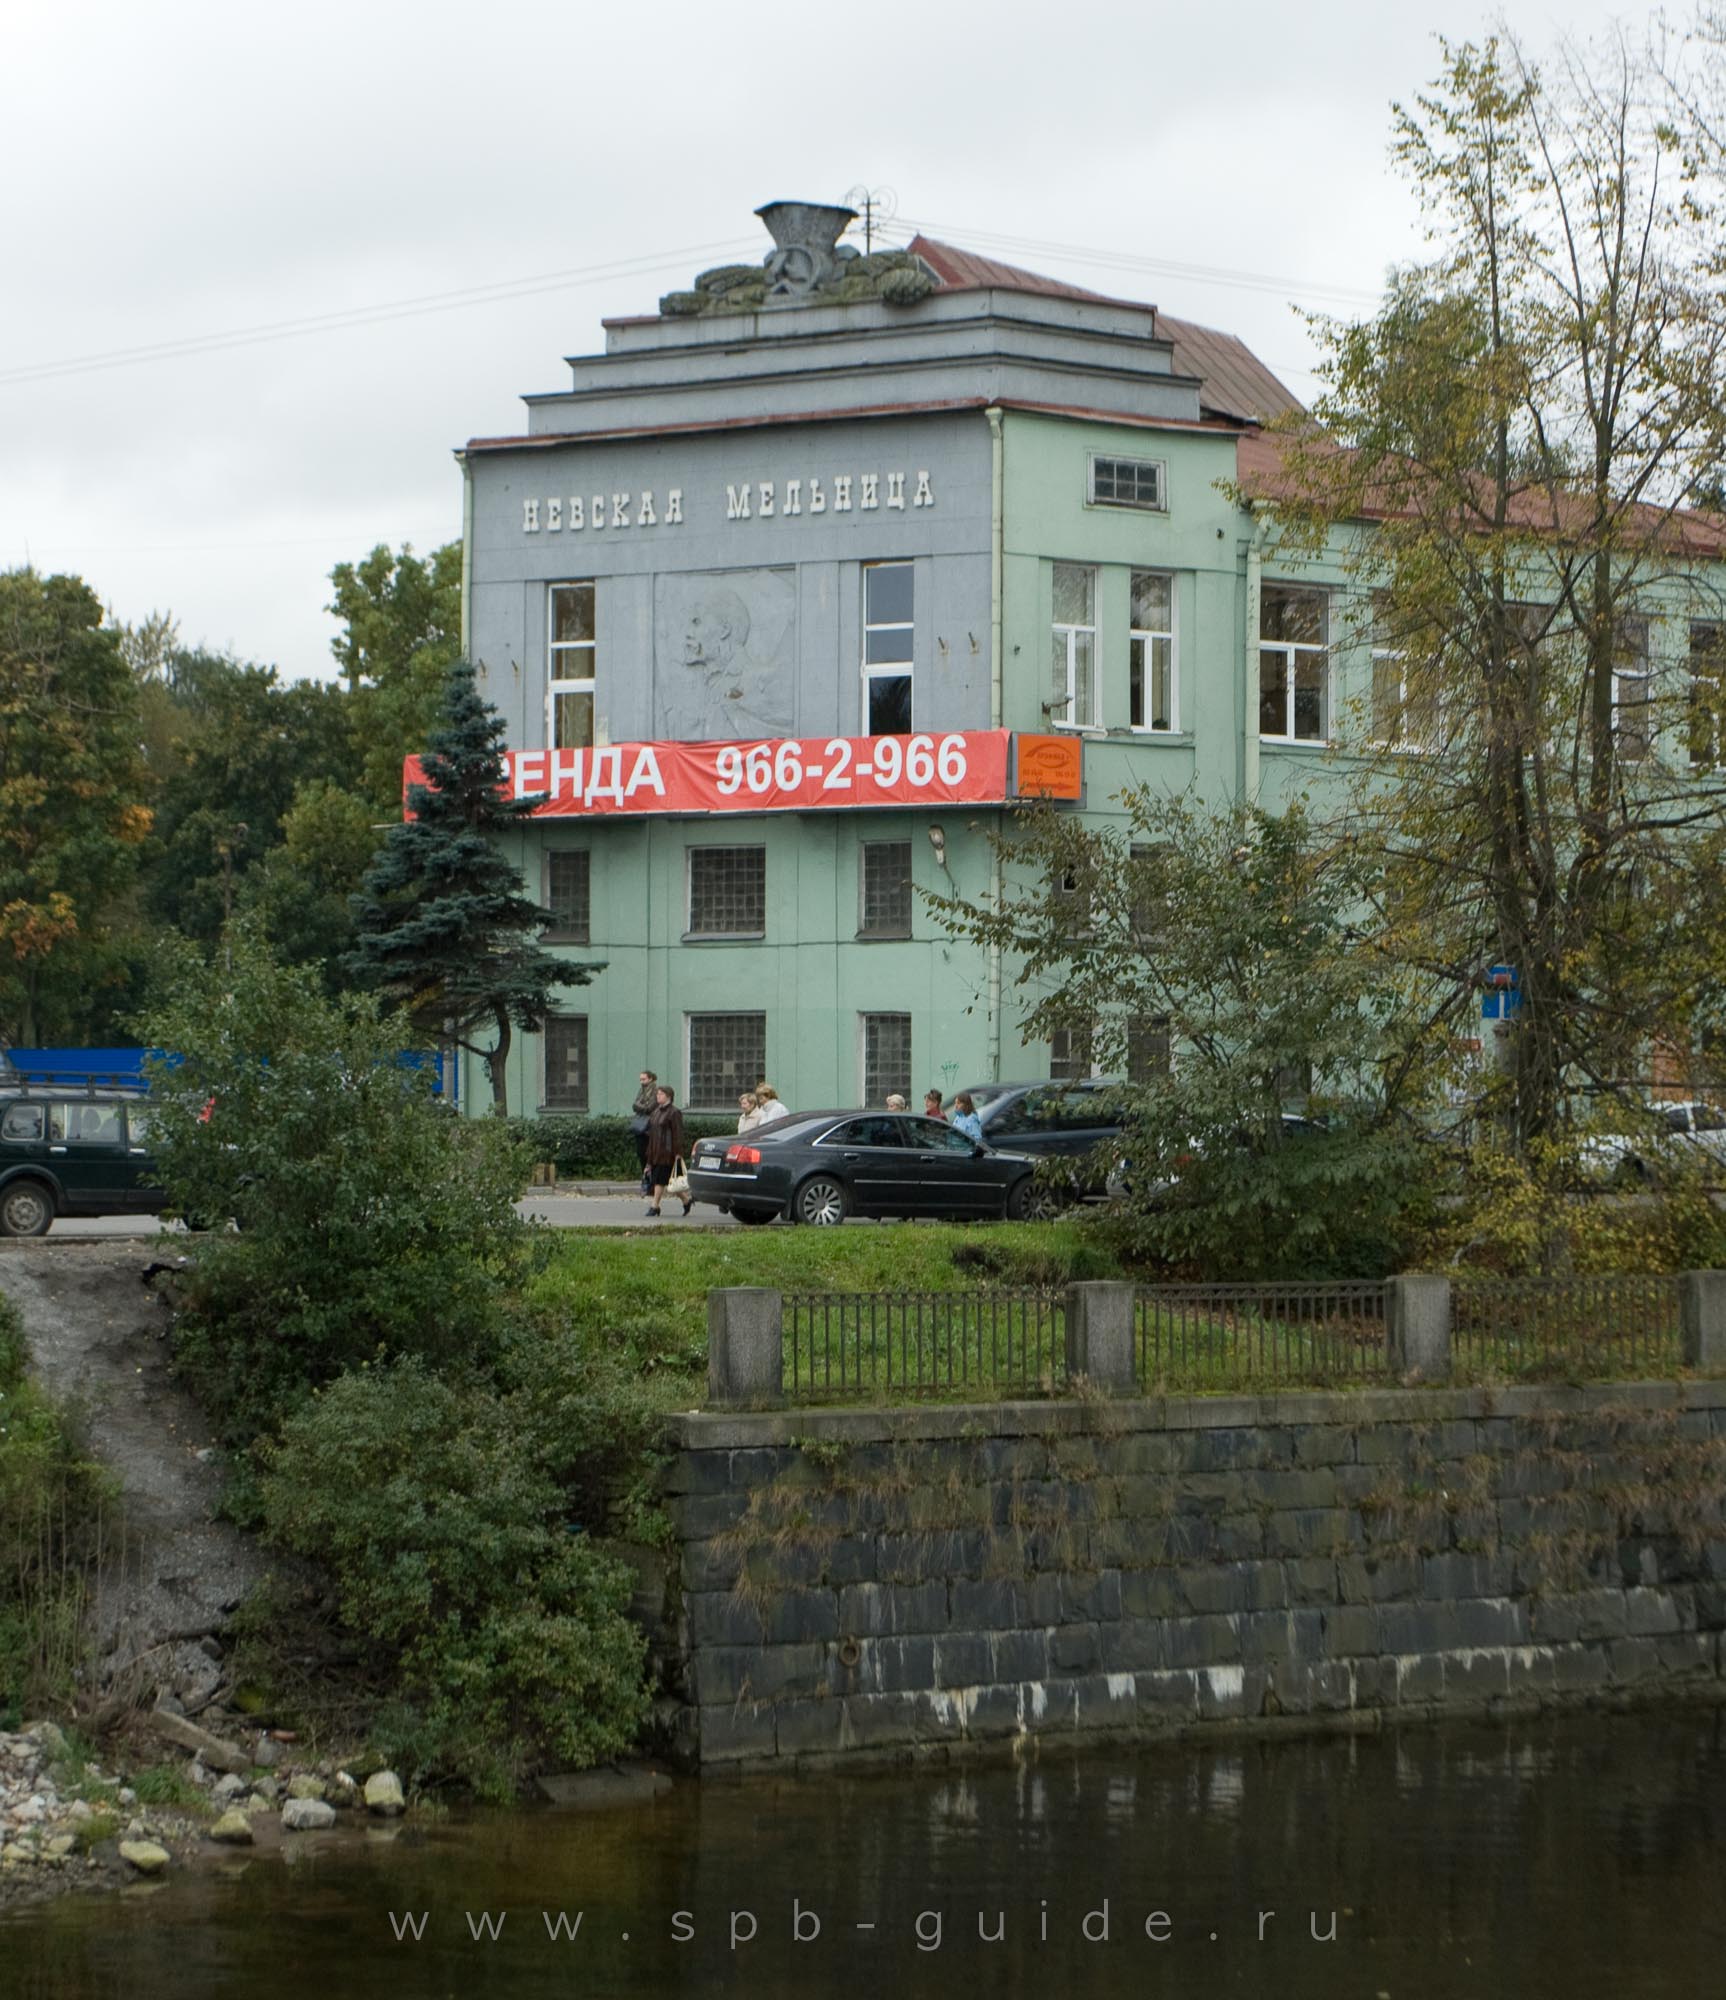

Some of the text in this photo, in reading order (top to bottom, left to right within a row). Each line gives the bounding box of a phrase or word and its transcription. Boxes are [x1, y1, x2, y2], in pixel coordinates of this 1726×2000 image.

[522, 470, 934, 533] НЕВСКАЯ МЕЛЬНИЦА
[480, 733, 967, 808] ЕНДА 966-2-966
